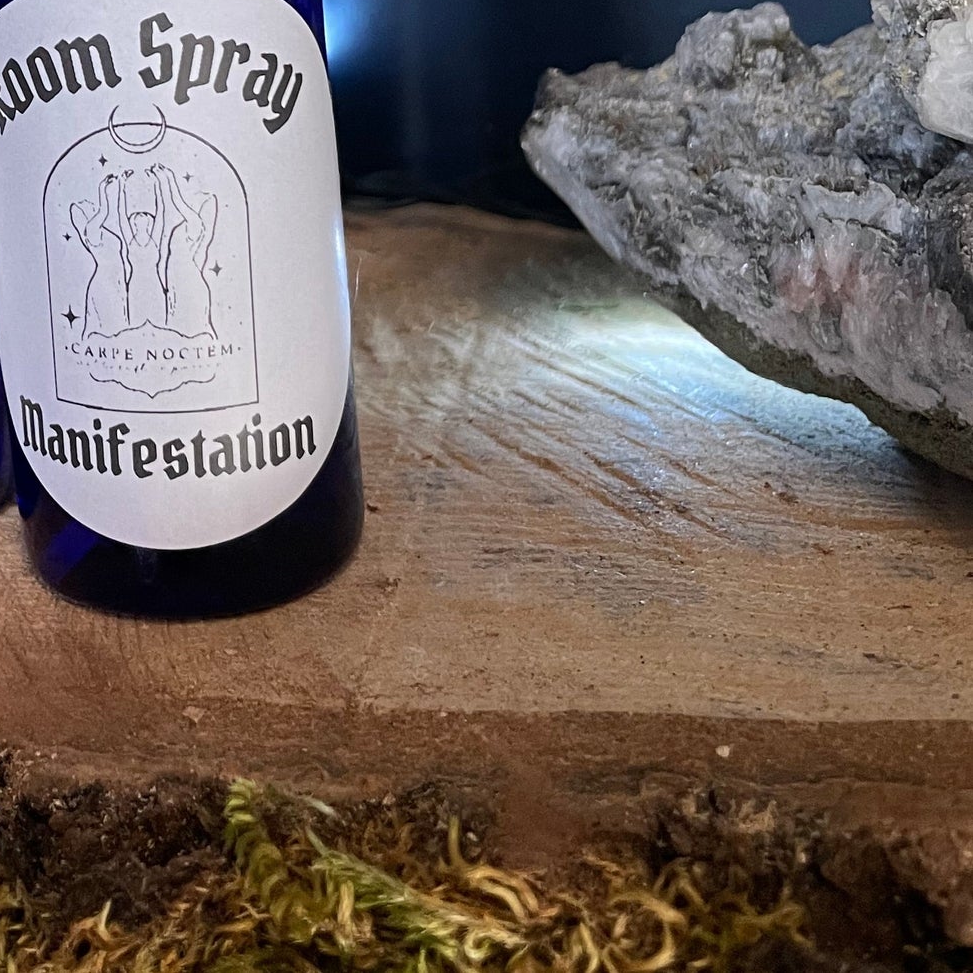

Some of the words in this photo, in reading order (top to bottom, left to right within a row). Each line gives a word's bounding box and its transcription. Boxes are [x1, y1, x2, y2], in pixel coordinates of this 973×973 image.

[138, 12, 303, 134] Spray
[71, 342, 134, 360] CARPE
[146, 344, 234, 360] NOCTEM
[20, 395, 317, 480] Manifestation
